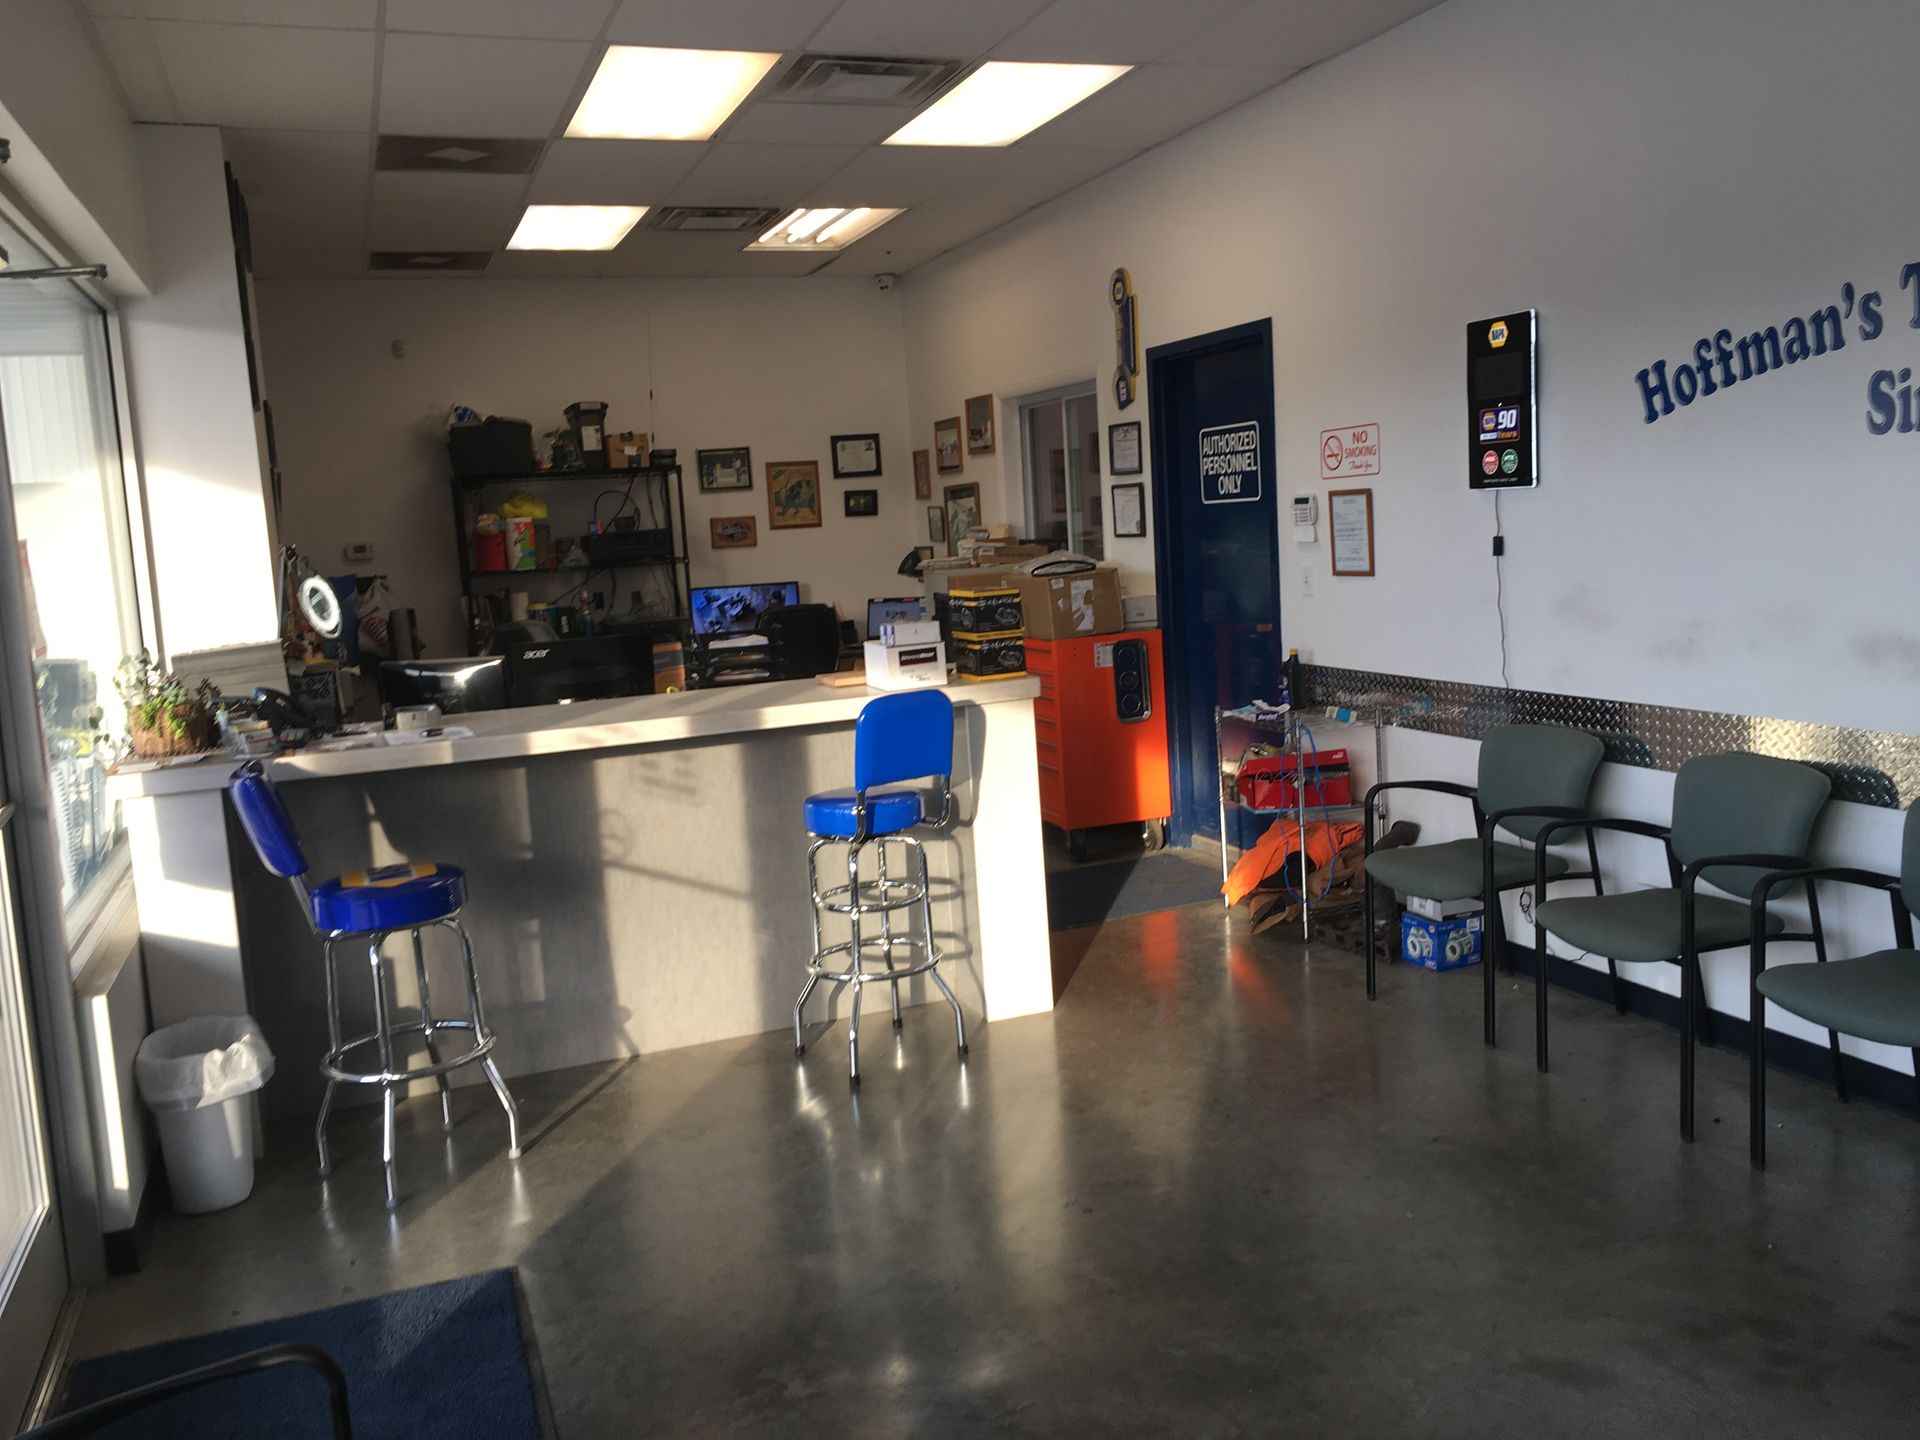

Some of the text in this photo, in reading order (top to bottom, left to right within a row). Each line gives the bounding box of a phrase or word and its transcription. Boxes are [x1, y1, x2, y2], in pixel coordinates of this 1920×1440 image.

[1634, 281, 1885, 425] Hoffman's
[1497, 409, 1517, 429] 90
[1202, 430, 1257, 456] AUTHORIZED
[1352, 430, 1369, 444] NO
[1344, 444, 1377, 459] SMOKING
[1203, 452, 1258, 476] PERSONNEL
[1218, 474, 1243, 495] ONLY
[522, 649, 551, 660] acer
